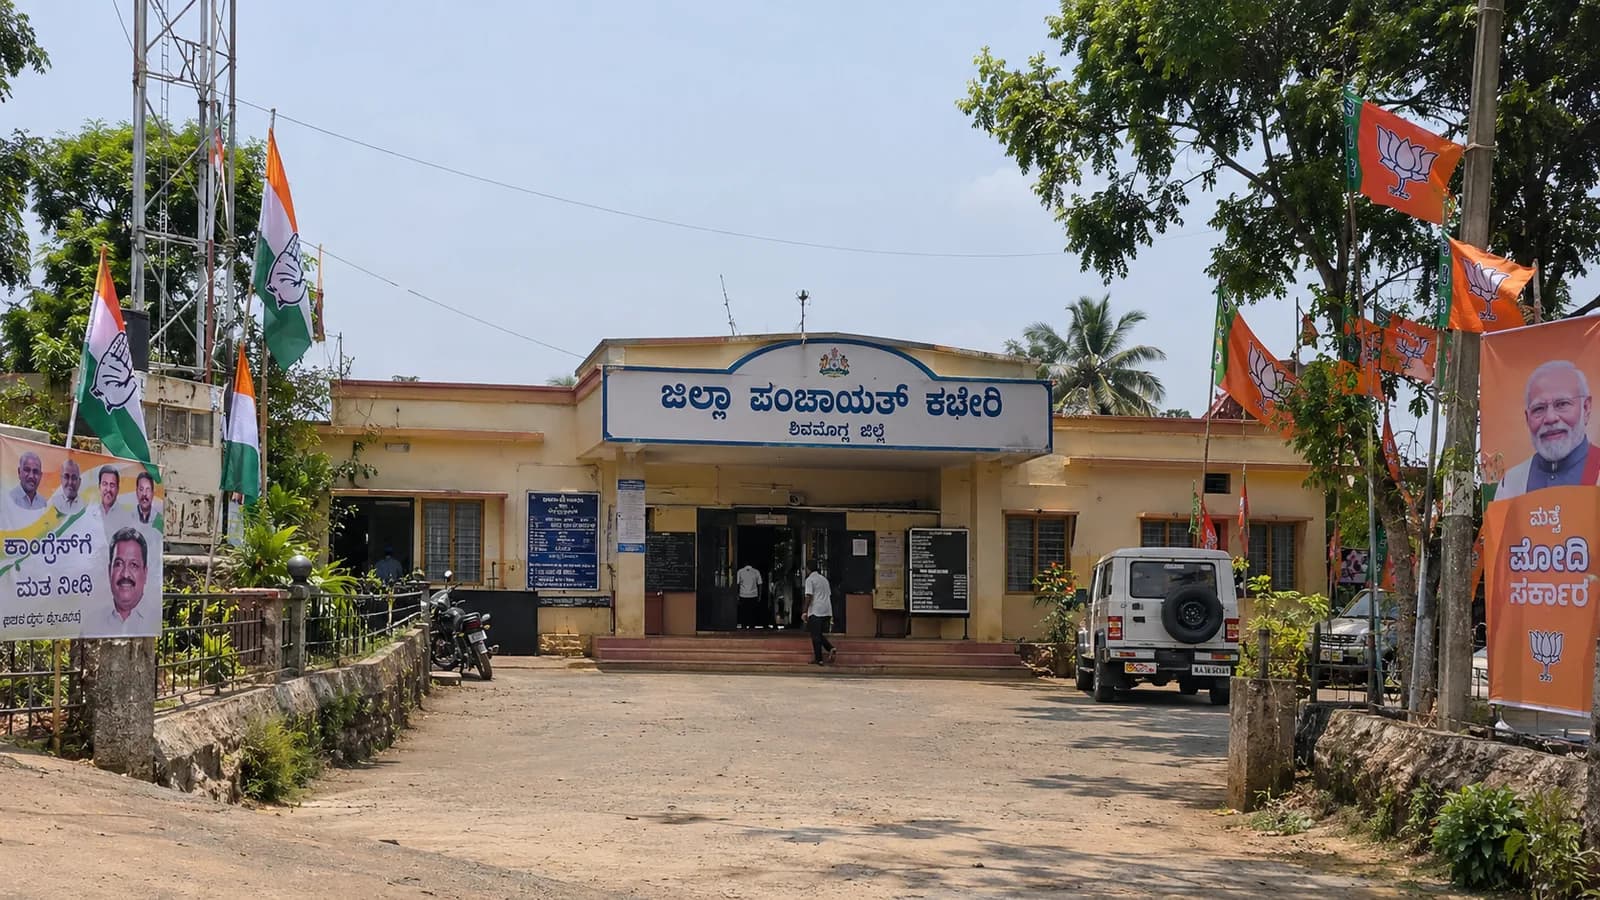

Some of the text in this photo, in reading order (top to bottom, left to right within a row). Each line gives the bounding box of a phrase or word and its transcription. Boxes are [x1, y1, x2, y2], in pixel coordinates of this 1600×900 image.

[661, 383, 731, 420] ಜಿಲ್ಲಾ
[750, 382, 909, 415] ಪಂಚಾಯತ್
[1510, 577, 1589, 607] ಸರ್ಕಾರ
